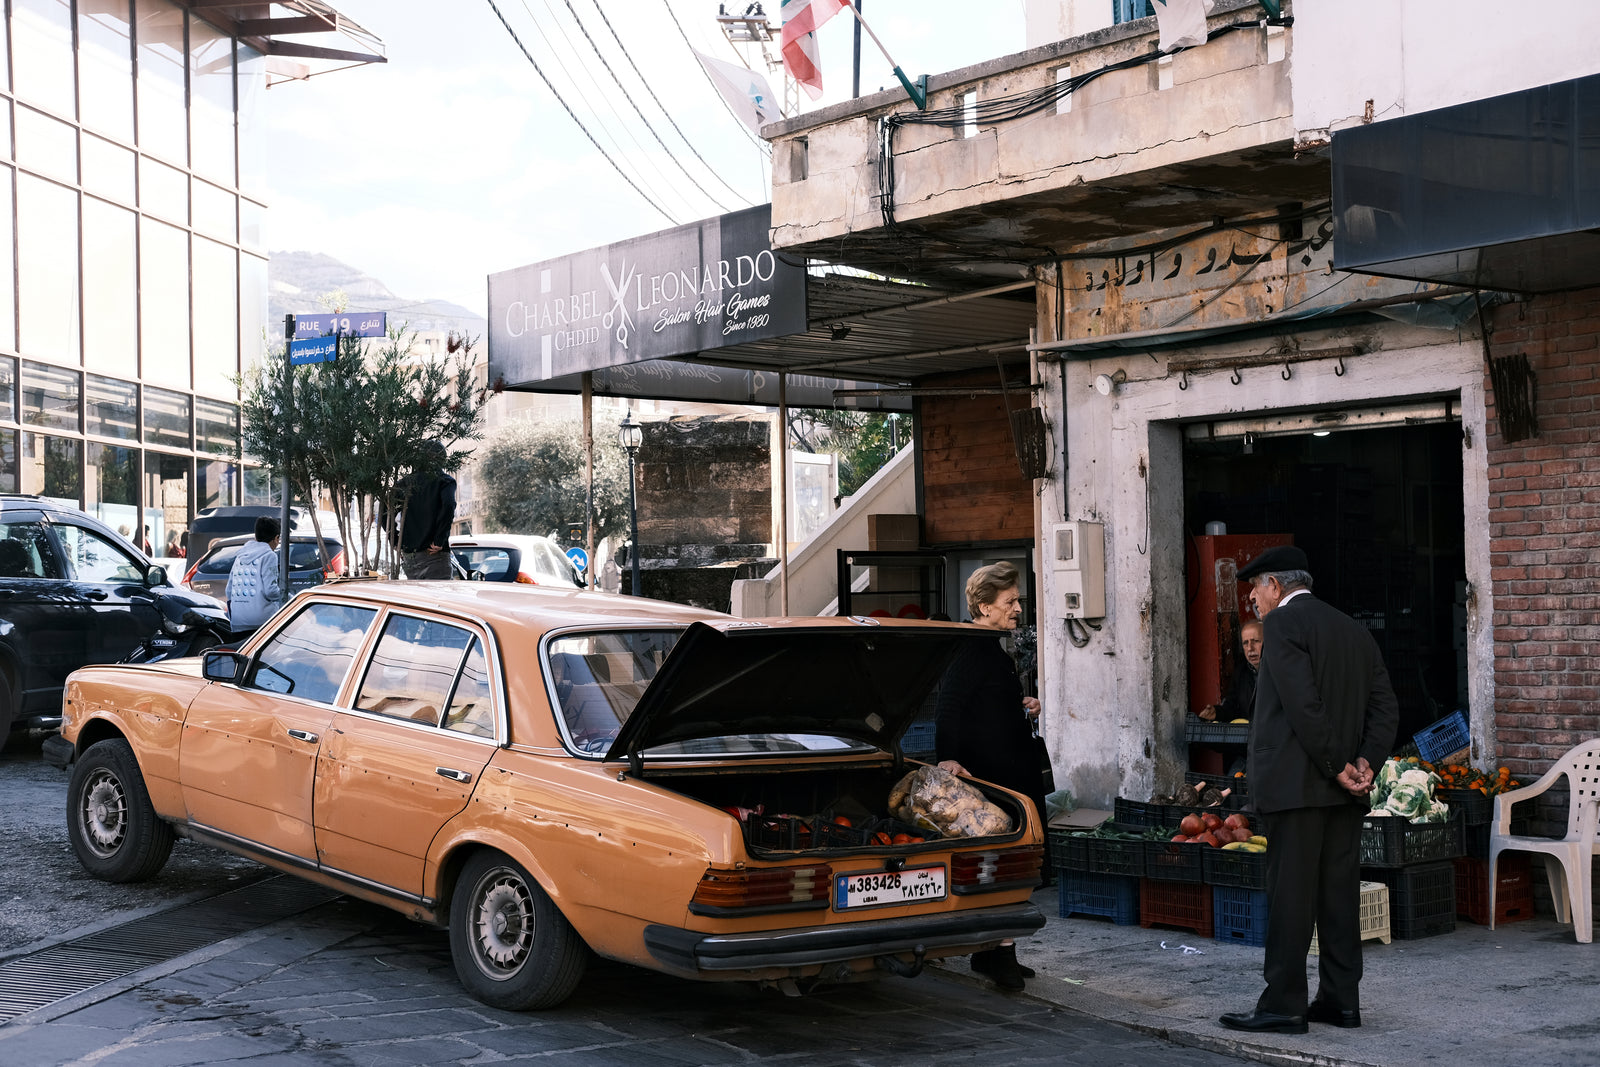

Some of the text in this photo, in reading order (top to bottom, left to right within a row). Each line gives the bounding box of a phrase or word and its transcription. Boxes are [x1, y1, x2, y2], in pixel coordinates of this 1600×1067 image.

[506, 249, 776, 338] CHARBEL LEONARDO
[653, 292, 771, 332] Salon Hair Games
[299, 317, 351, 333] RUE 19
[360, 319, 380, 331] شارع
[722, 317, 747, 336] Since
[554, 326, 599, 351] CHDID
[856, 873, 902, 893] 383426
